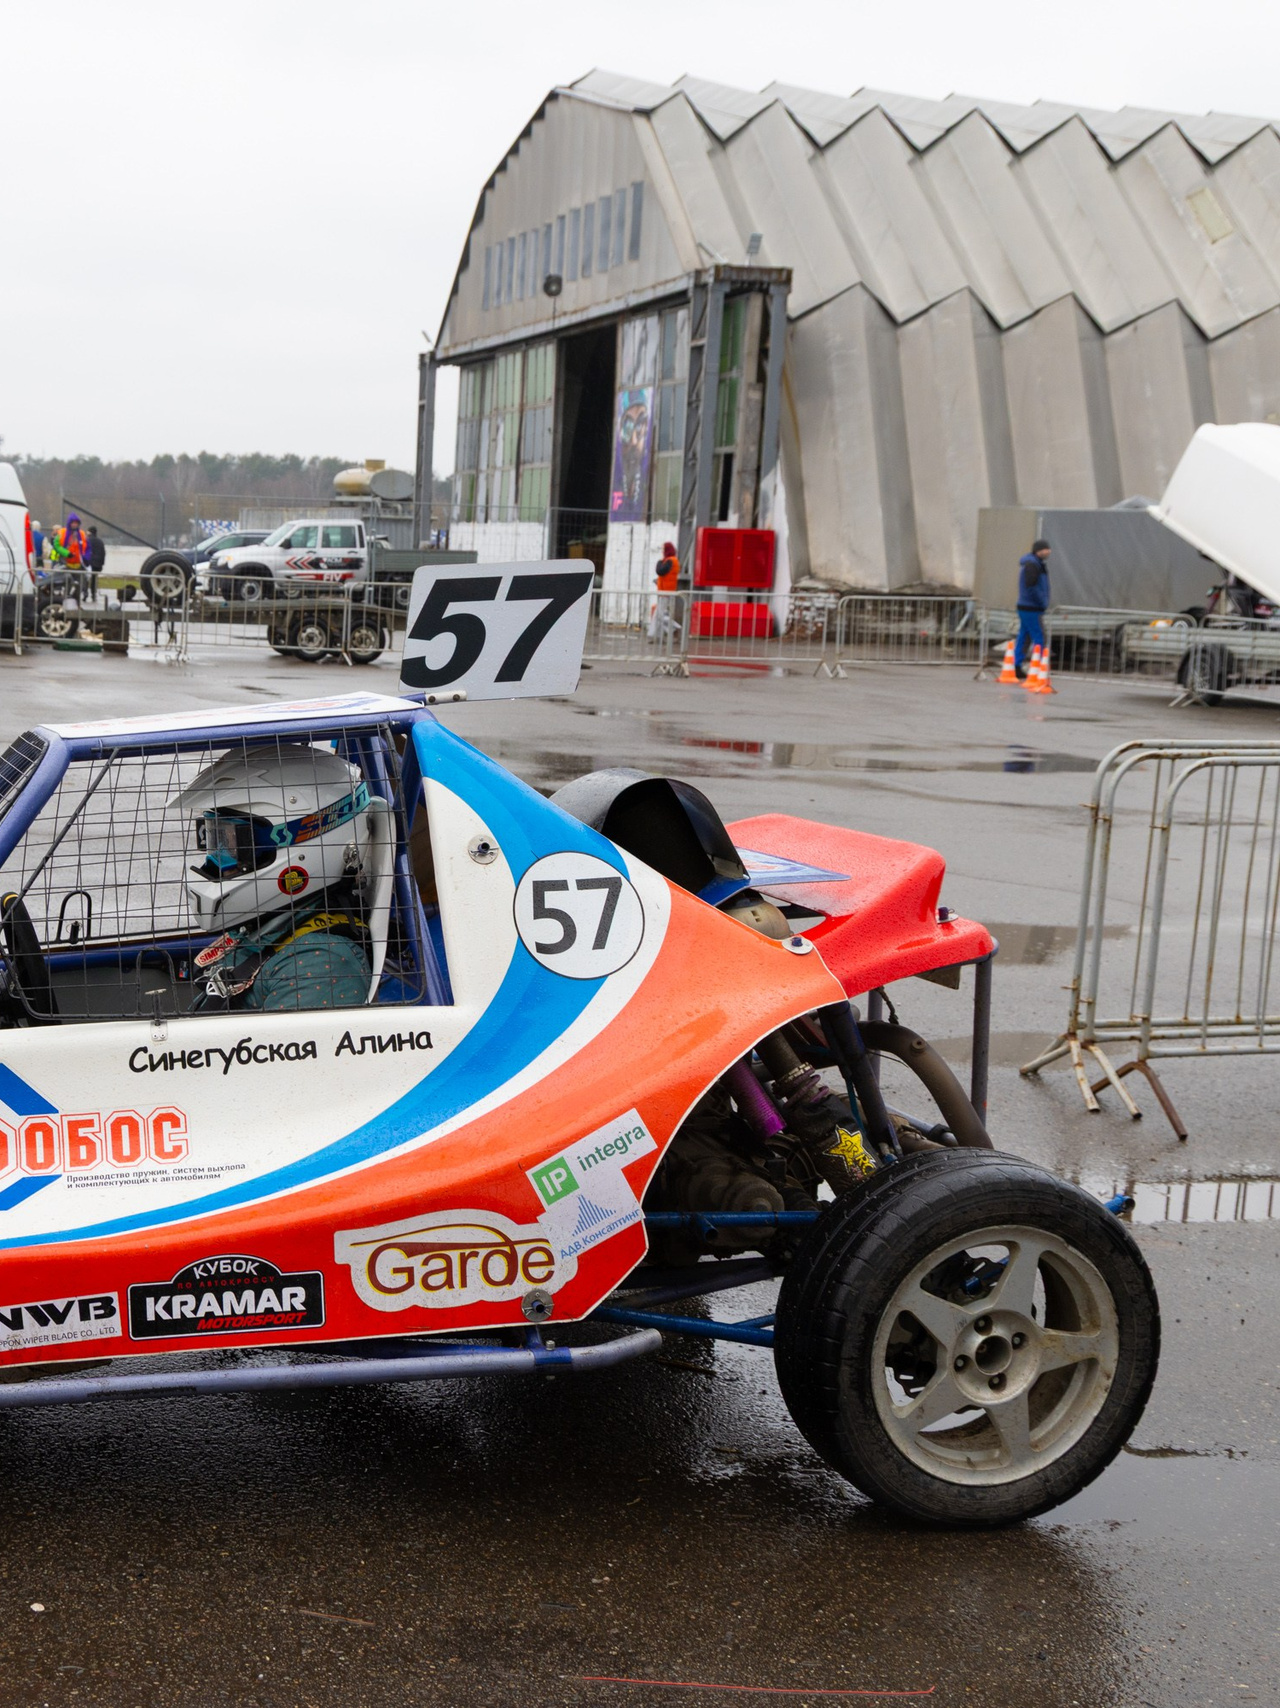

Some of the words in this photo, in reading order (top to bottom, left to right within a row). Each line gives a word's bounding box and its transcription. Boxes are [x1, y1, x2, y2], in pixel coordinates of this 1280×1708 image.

[399, 571, 594, 688] 57
[532, 877, 622, 955] 57
[129, 1037, 317, 1075] Синегубская
[335, 1031, 433, 1056] Алина
[67, 1171, 130, 1183] Производство
[173, 1166, 205, 1176] систем
[208, 1163, 246, 1173] выхлопа
[541, 1167, 568, 1197] IP
[577, 1126, 646, 1171] integra
[75, 1177, 150, 1189] комплектующих
[160, 1172, 221, 1182] автомобилям
[193, 1259, 260, 1280] КУБОК
[366, 1224, 556, 1295] Garde
[177, 1281, 192, 1290] ПО
[199, 1276, 275, 1288] АВТОКРОССУ
[146, 1286, 307, 1321] KRAMAR
[23, 1335, 49, 1344] WIPER
[51, 1331, 78, 1341] BLADE
[100, 1326, 118, 1335] LTD.
[197, 1312, 307, 1330] MOTORSPORT
